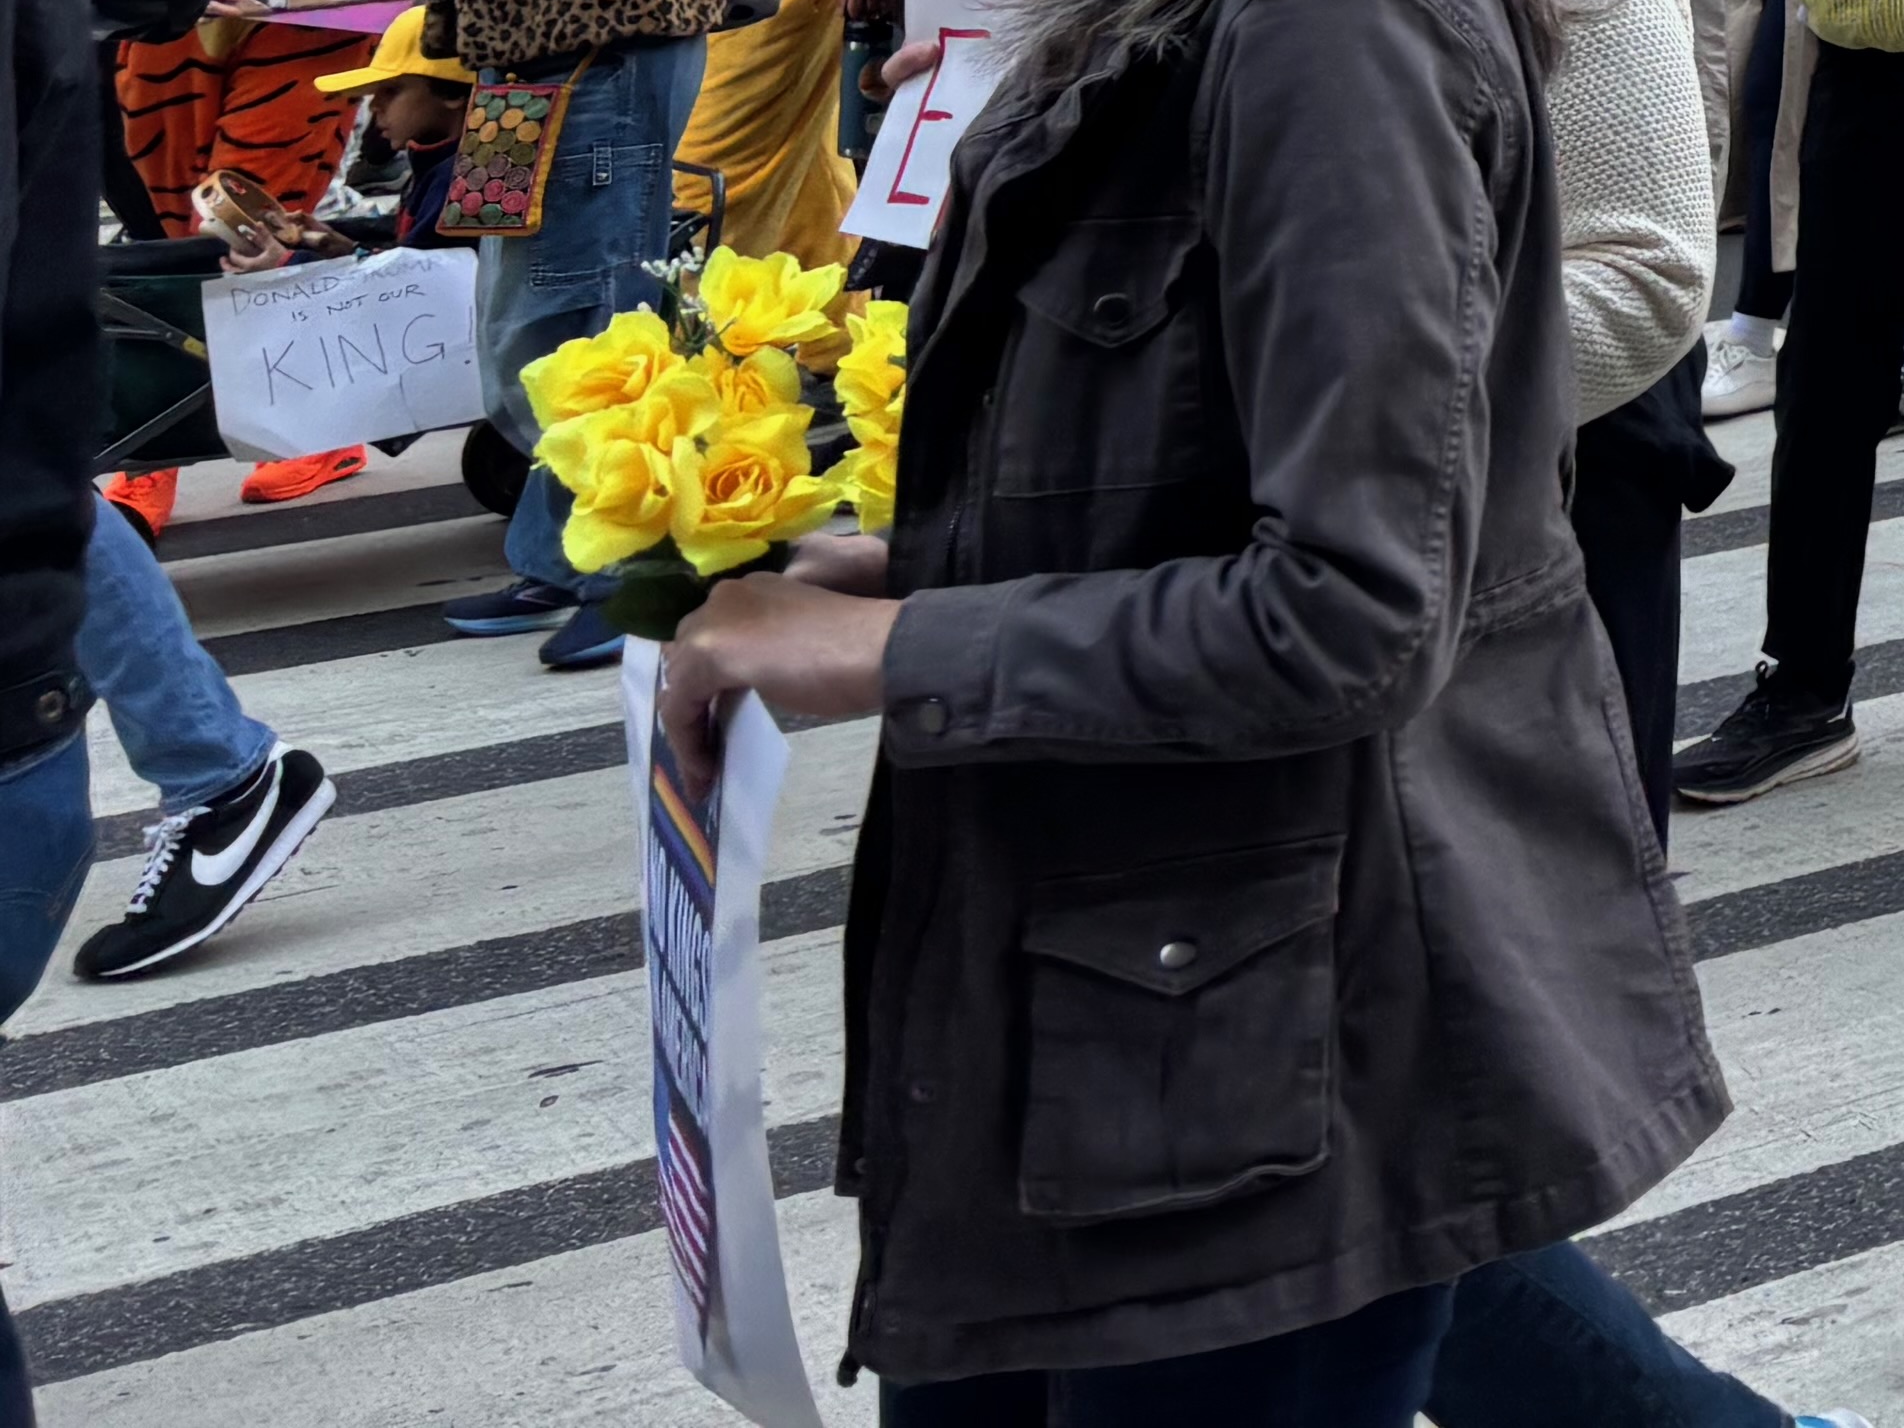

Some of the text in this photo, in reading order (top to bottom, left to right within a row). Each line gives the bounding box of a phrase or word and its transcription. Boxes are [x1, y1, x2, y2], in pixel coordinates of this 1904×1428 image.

[230, 275, 341, 316] DONALD
[291, 283, 427, 323] IS NOT OUR
[261, 305, 475, 407] KING!
